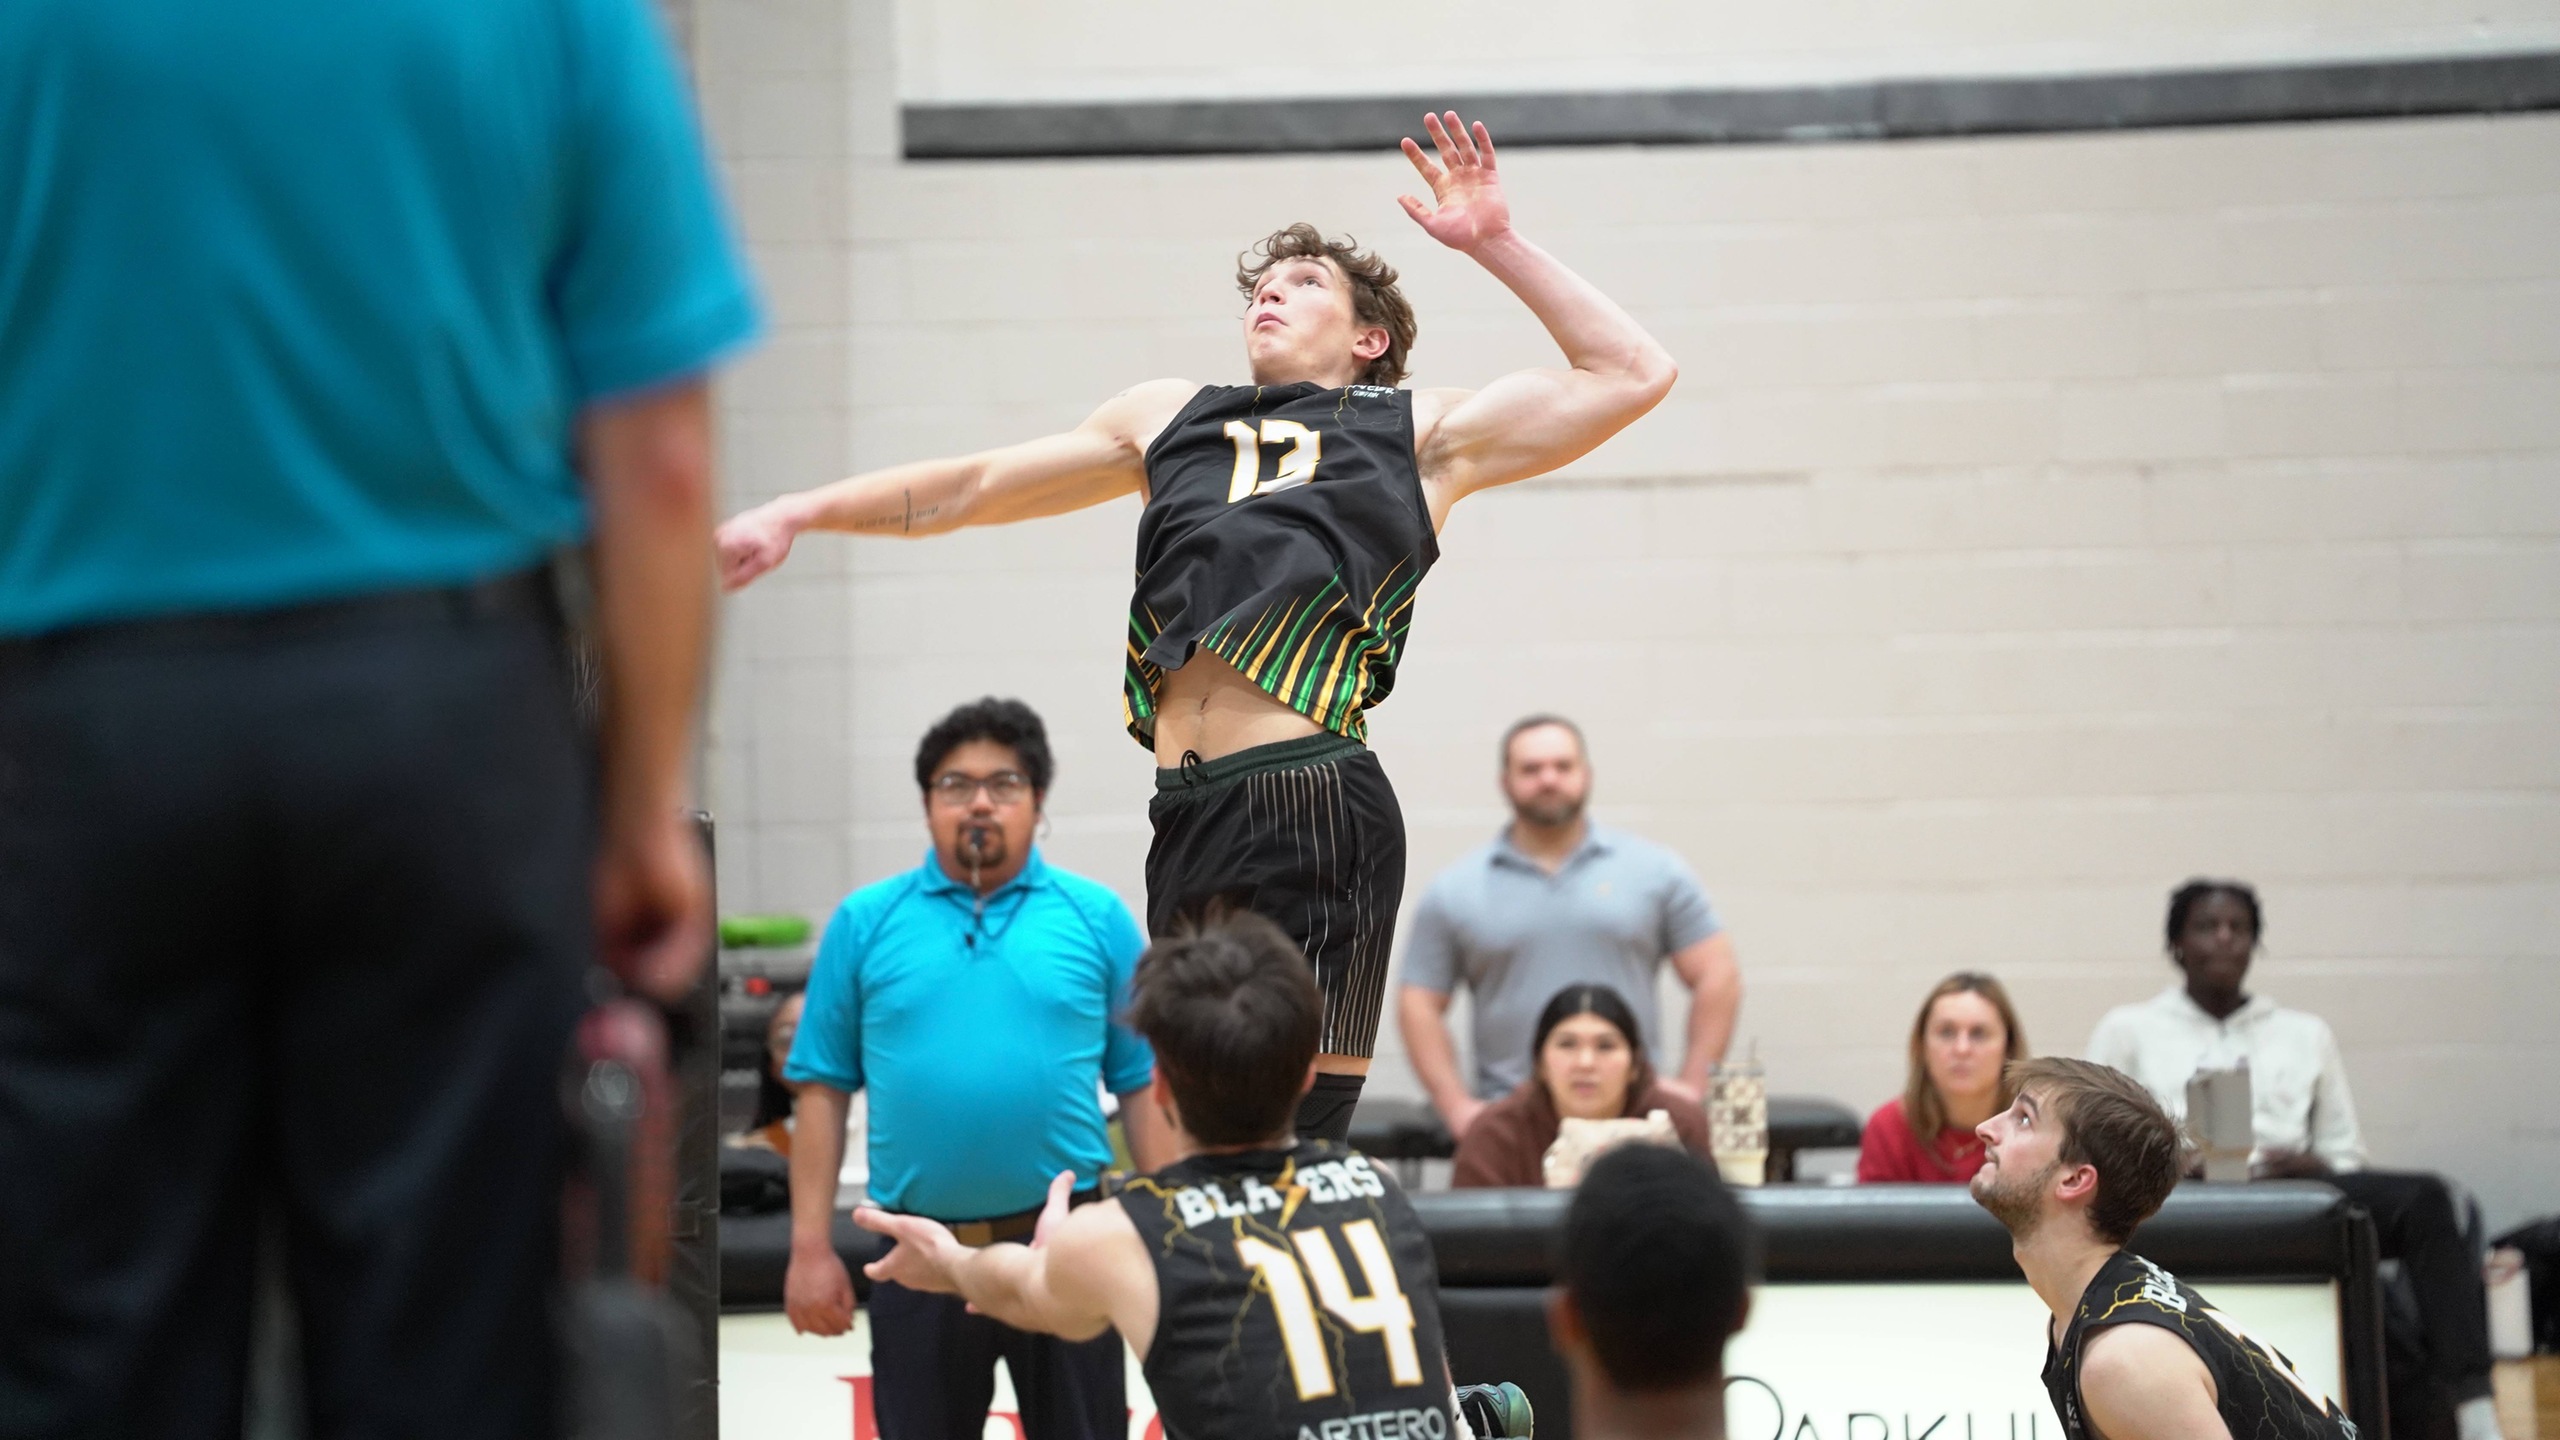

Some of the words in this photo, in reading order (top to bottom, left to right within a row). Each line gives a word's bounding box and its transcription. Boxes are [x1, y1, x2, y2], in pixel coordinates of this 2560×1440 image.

[1223, 419, 1321, 504] 13
[1234, 1217, 1424, 1401] 14
[1297, 1406, 1447, 1440] ARTERO
